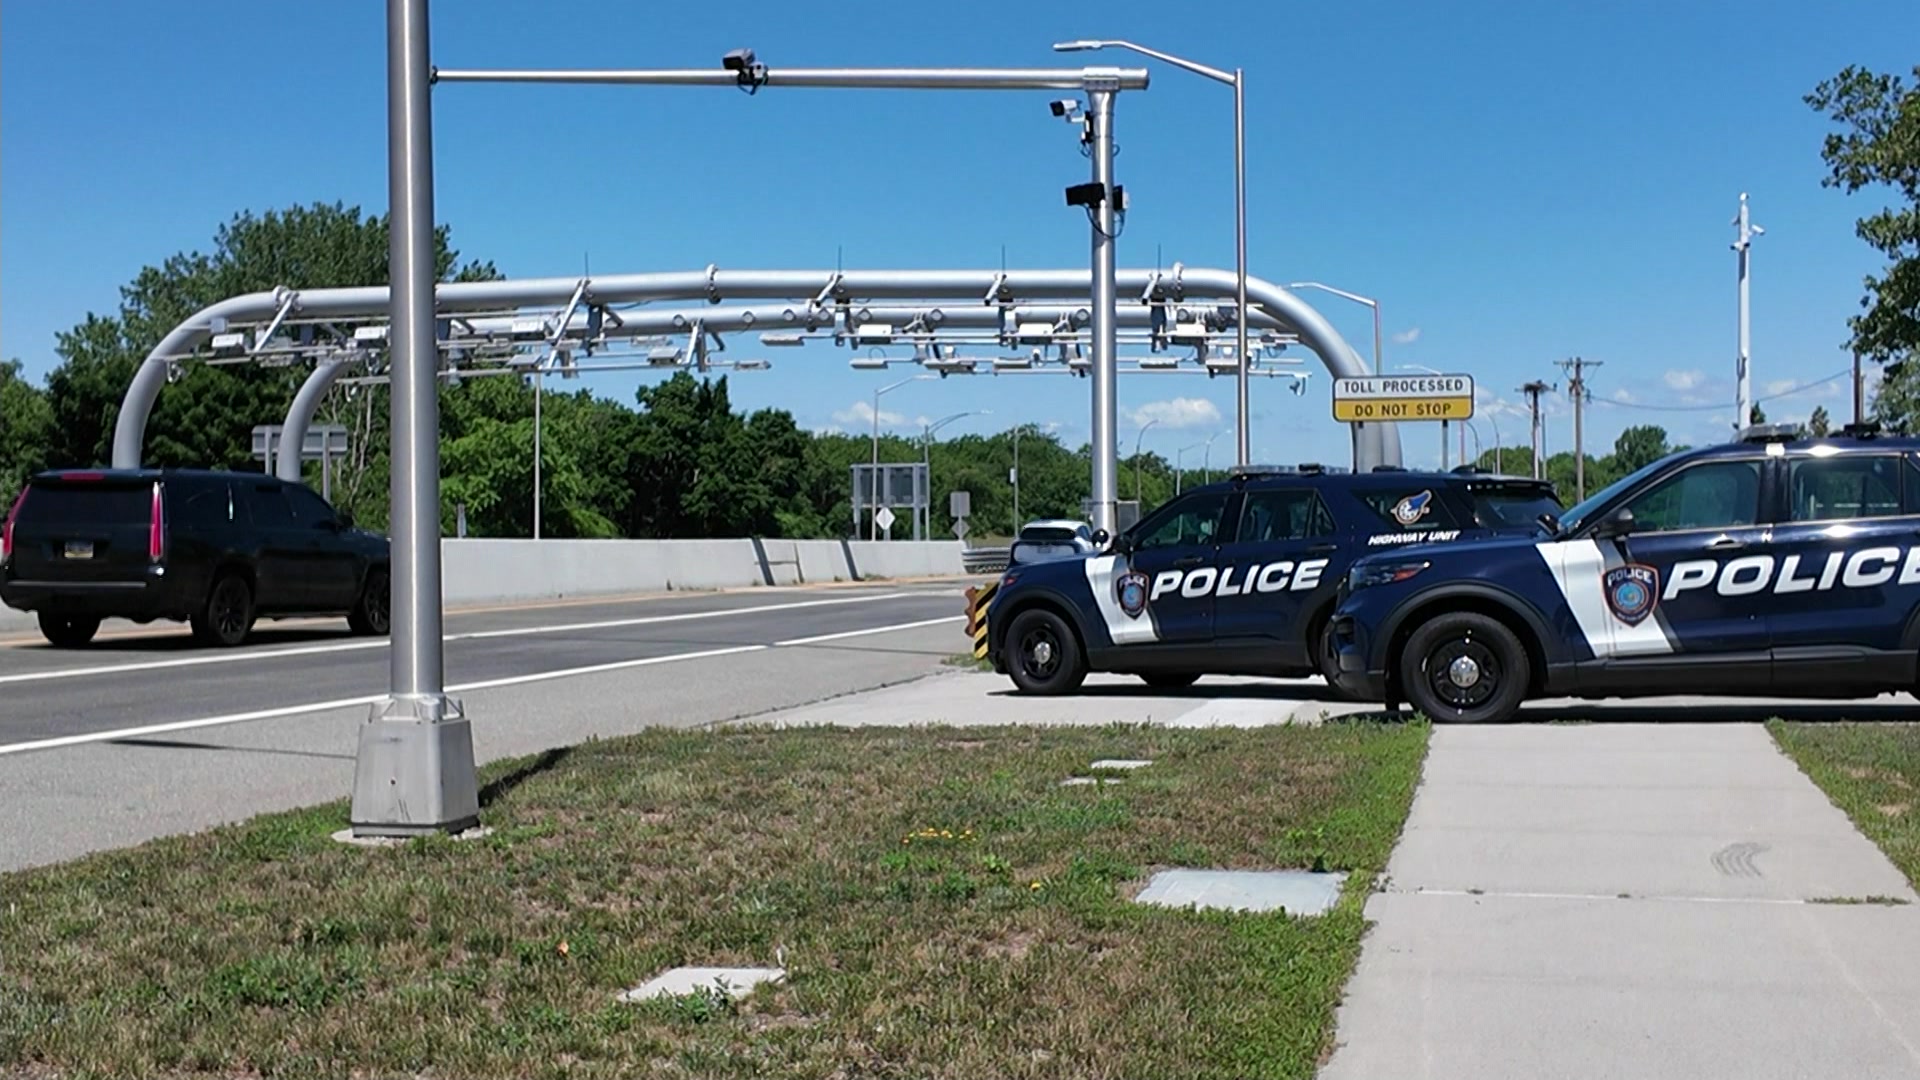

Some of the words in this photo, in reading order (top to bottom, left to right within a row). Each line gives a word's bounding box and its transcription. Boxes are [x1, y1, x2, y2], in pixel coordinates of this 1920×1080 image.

[1344, 381, 1375, 393] TOLL
[1382, 379, 1464, 393] PROCESSED
[1354, 404, 1373, 416] DO
[1381, 404, 1407, 416] NOT
[1416, 403, 1452, 415] STOP
[1367, 531, 1427, 546] HIGHWAY
[1428, 530, 1461, 541] UNIT
[1150, 558, 1330, 601] POLICE
[1607, 567, 1652, 587] POLICE
